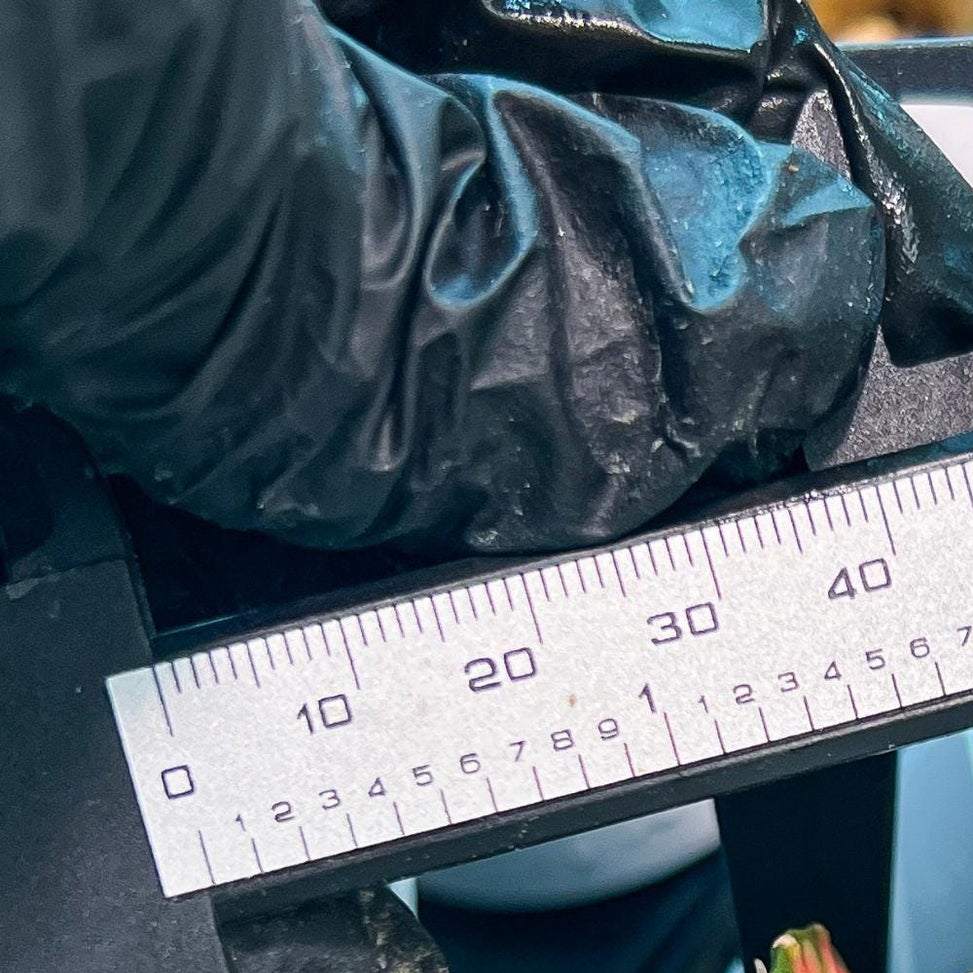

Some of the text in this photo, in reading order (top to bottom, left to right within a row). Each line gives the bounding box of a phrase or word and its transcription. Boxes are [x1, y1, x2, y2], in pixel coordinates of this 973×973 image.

[271, 801, 295, 823] 2
[318, 789, 341, 811] 3
[367, 777, 386, 798] 4
[411, 764, 433, 787] 5
[459, 752, 480, 775] 6
[508, 740, 525, 763] 7
[550, 729, 575, 752] 8
[597, 718, 619, 741] 9
[638, 683, 656, 714] 1
[732, 683, 755, 705] 2
[777, 671, 799, 693] 3
[823, 660, 842, 681] 4
[865, 648, 886, 671] 5
[909, 637, 931, 659] 6
[955, 625, 972, 648] 7
[296, 693, 353, 735] 10
[464, 647, 537, 693] 20
[646, 601, 719, 646] 30
[827, 557, 892, 600] 40
